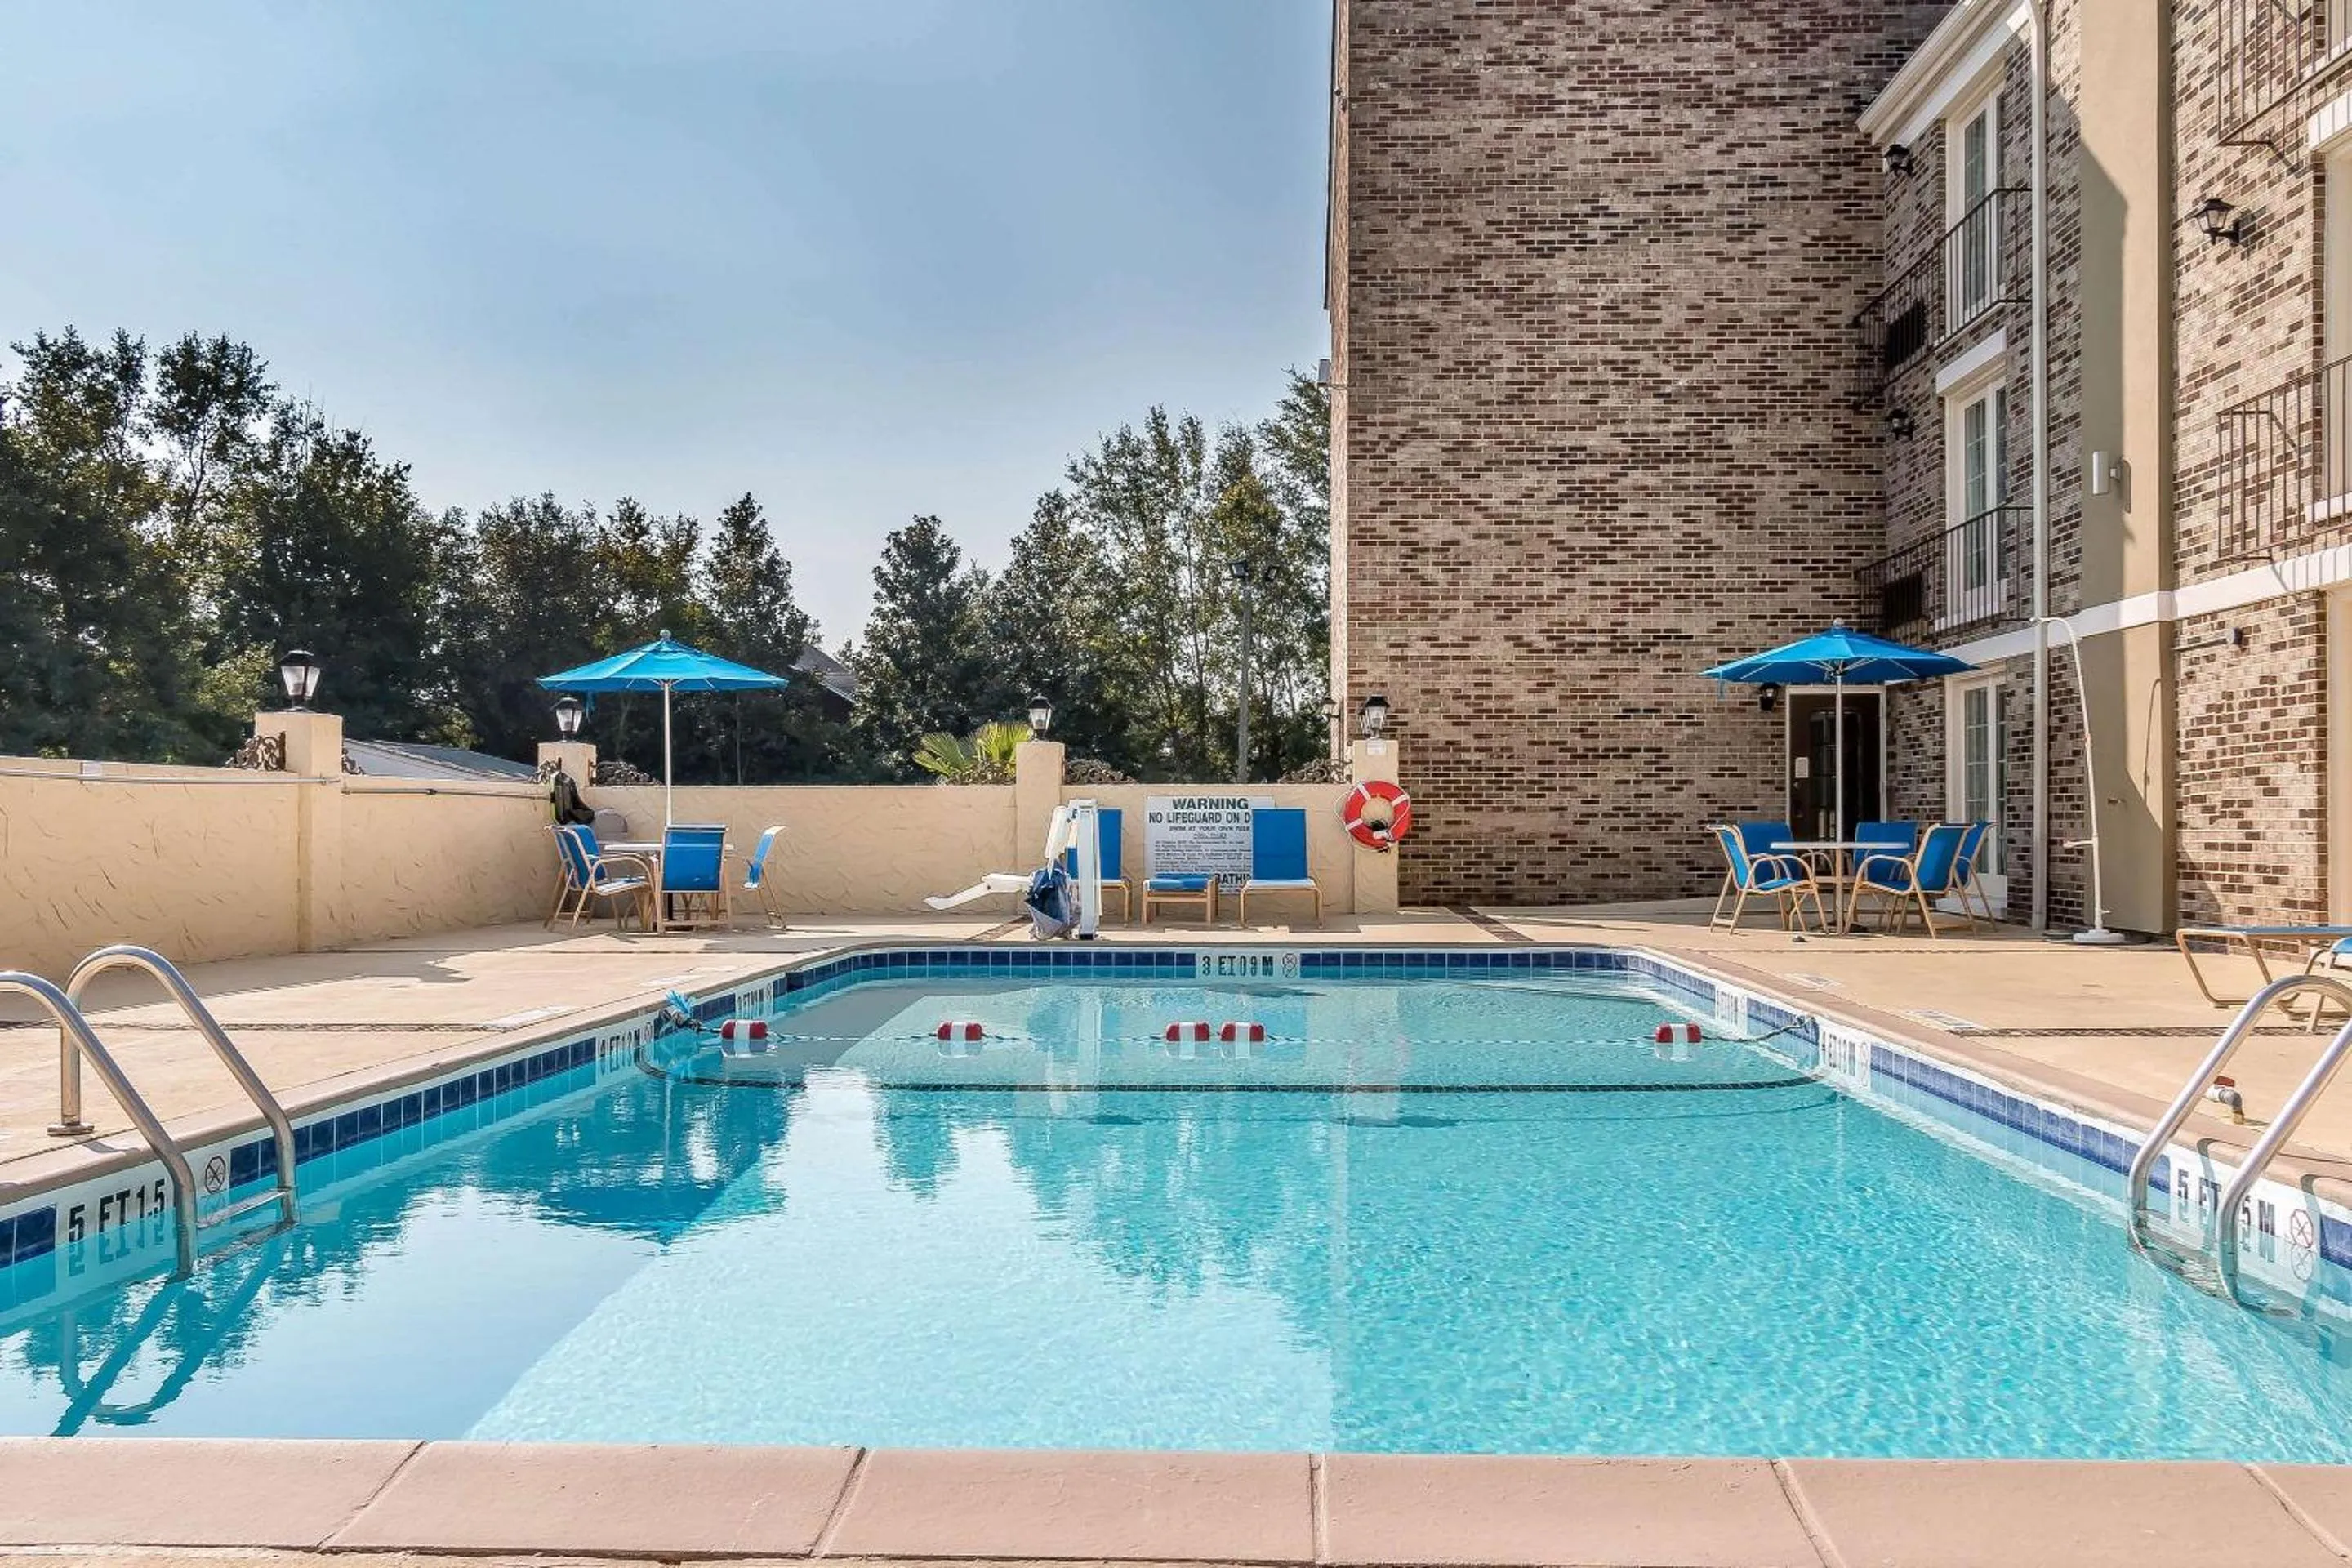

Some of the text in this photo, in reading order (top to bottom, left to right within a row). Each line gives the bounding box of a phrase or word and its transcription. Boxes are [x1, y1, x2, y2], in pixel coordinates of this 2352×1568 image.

[1172, 798, 1249, 809] WARNING
[1149, 812, 1163, 823] NO
[1167, 812, 1222, 823] LIFEGUARD
[1226, 812, 1240, 823] ON
[69, 1204, 86, 1242] 5
[99, 1189, 131, 1233] FT
[2258, 1199, 2275, 1236] M
